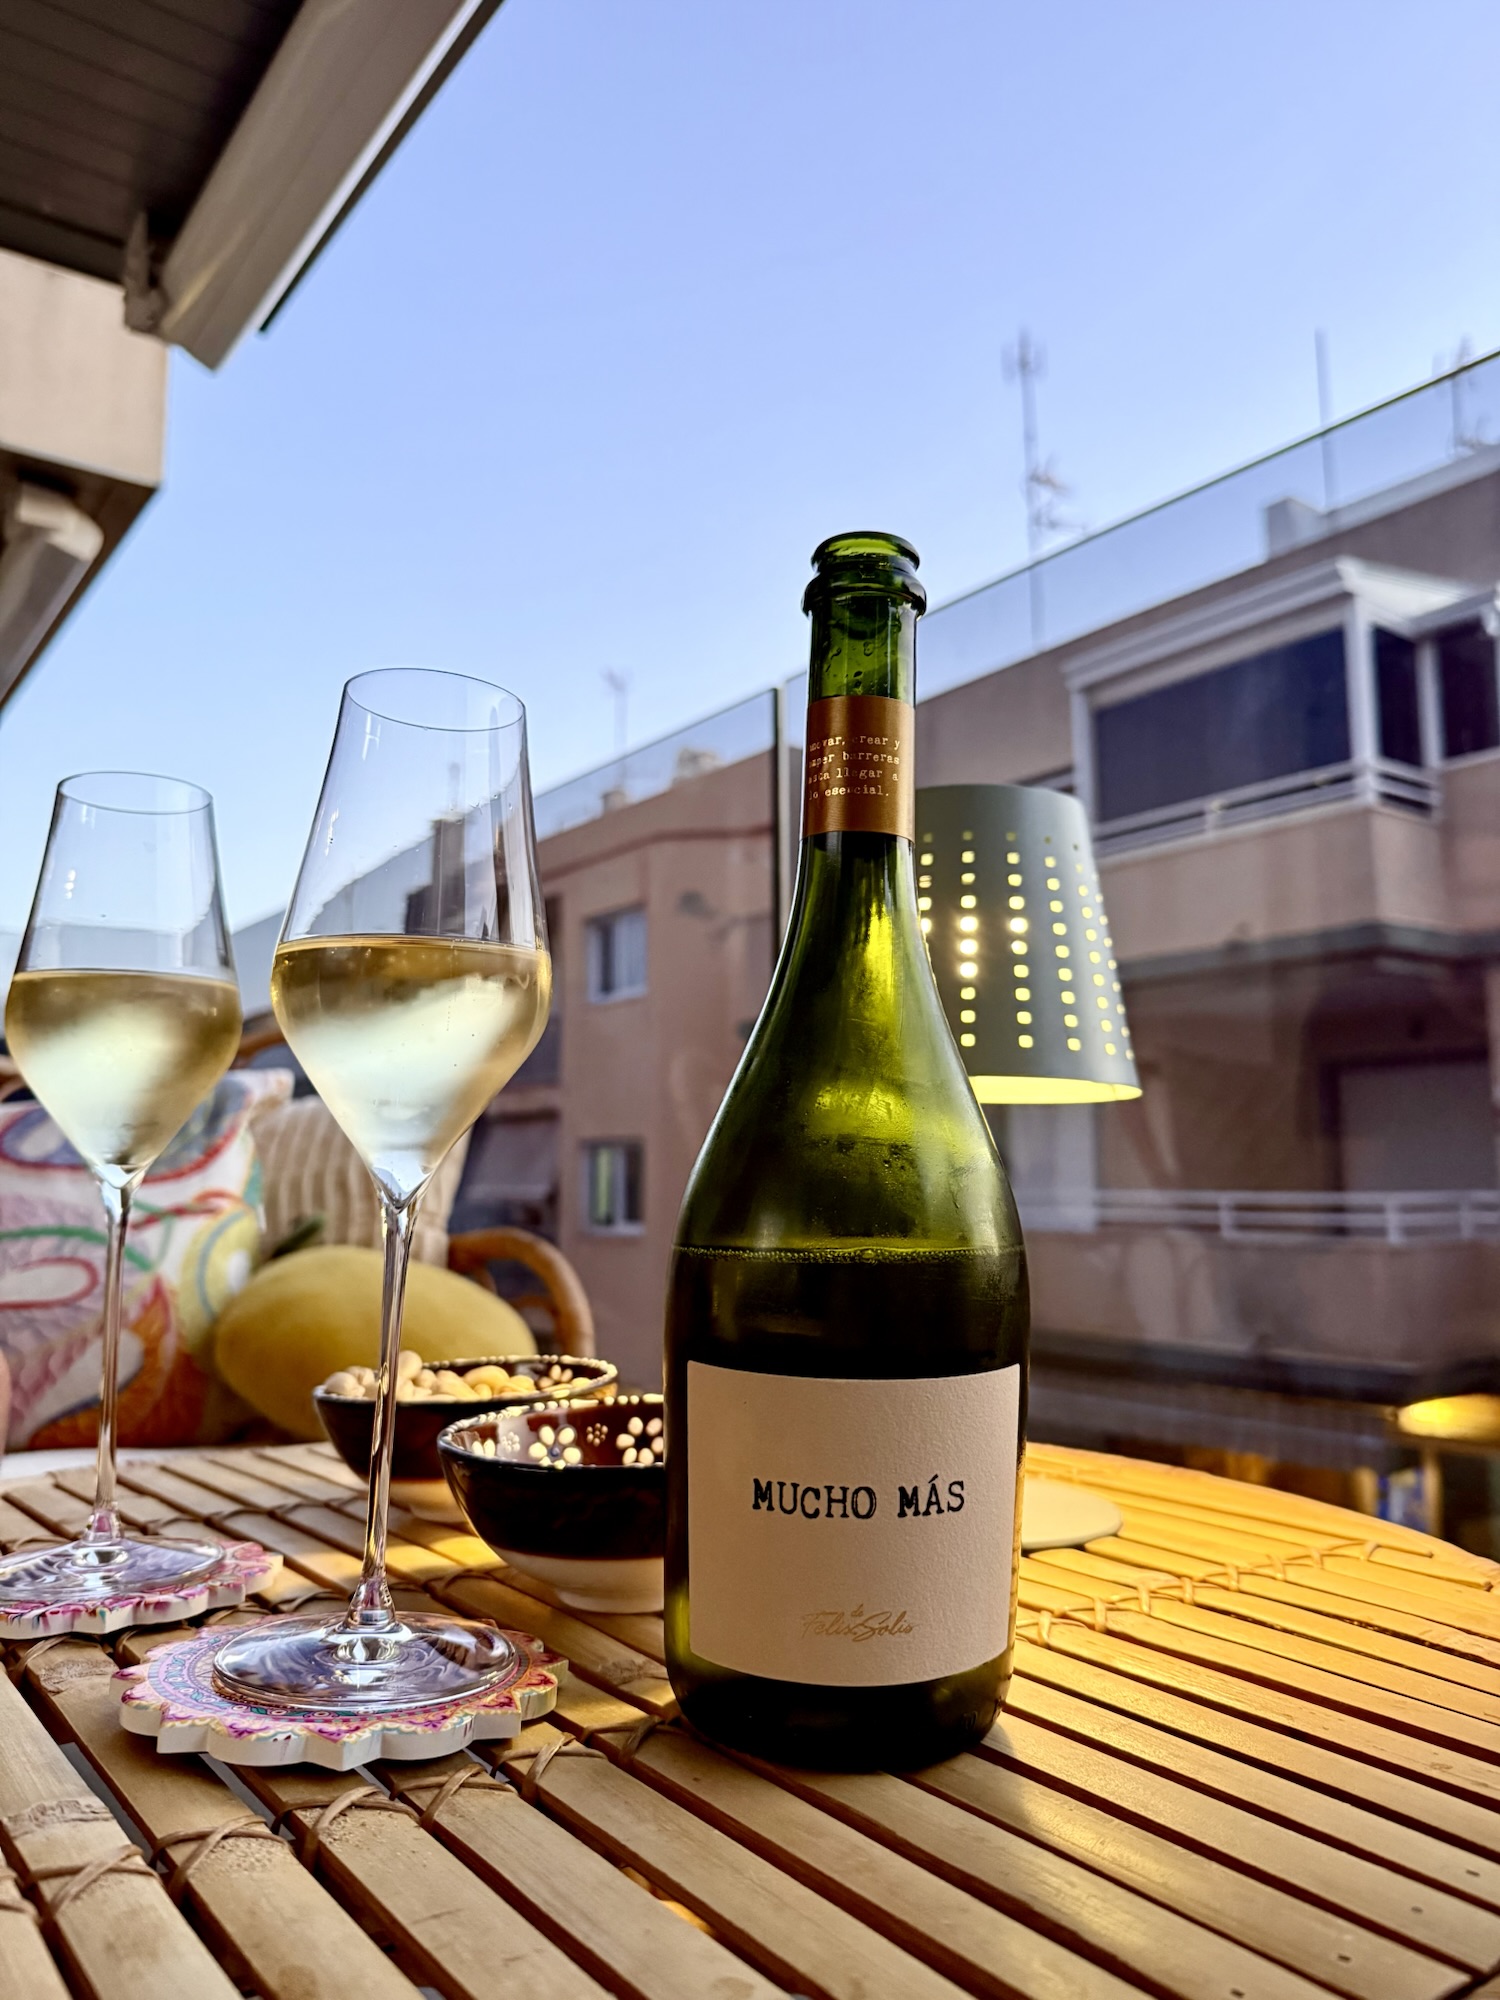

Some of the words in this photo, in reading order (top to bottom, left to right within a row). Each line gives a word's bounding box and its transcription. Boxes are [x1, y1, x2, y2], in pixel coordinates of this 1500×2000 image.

[894, 739, 901, 750] y
[892, 773, 899, 782] a
[752, 1478, 877, 1519] MUCHO
[897, 1473, 965, 1518] MÁS
